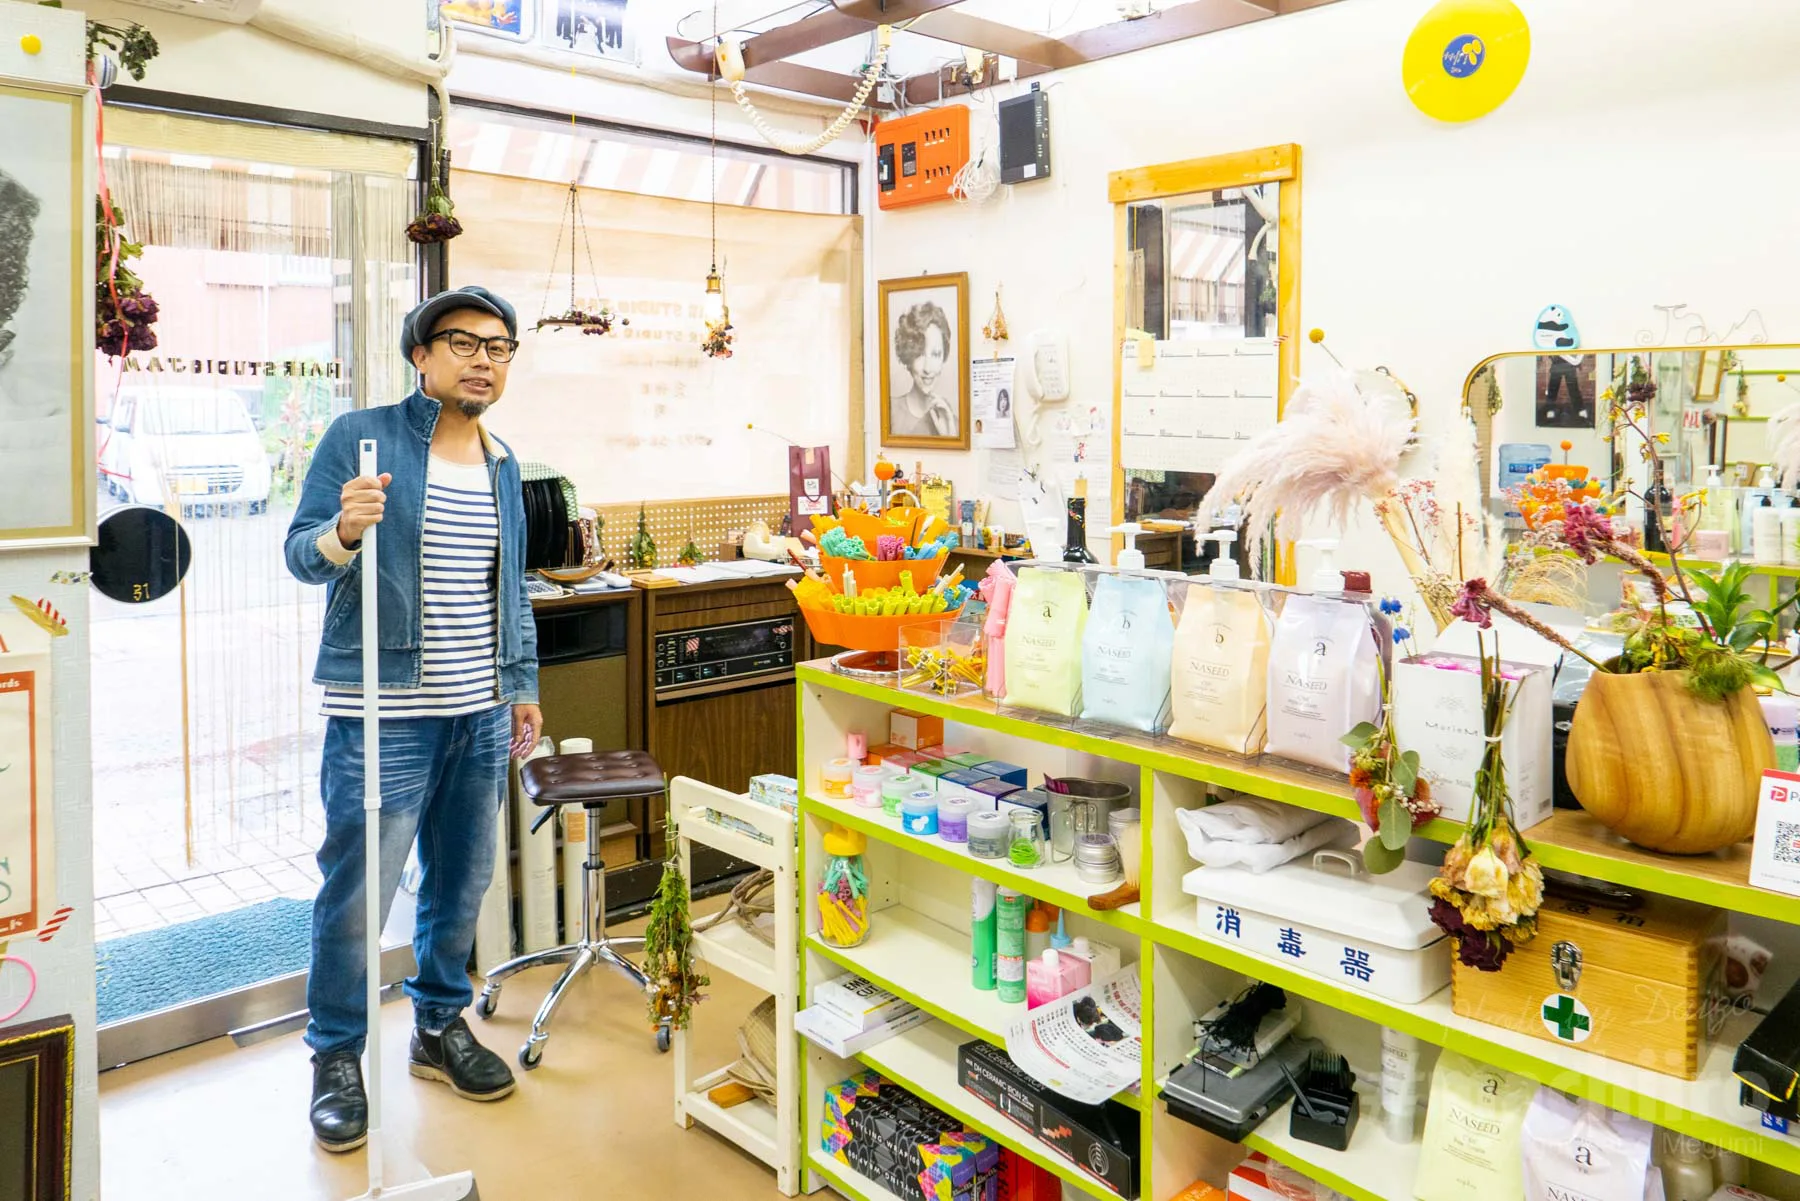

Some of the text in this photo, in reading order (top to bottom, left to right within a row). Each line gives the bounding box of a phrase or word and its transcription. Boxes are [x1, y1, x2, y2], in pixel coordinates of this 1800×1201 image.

[133, 583, 150, 601] 31
[1314, 641, 1326, 656] a
[1190, 661, 1230, 677] NASEED
[1216, 905, 1375, 982] 消毒器
[1483, 1078, 1499, 1096] a
[1450, 1108, 1500, 1135] NASEED
[1575, 1146, 1592, 1166] a
